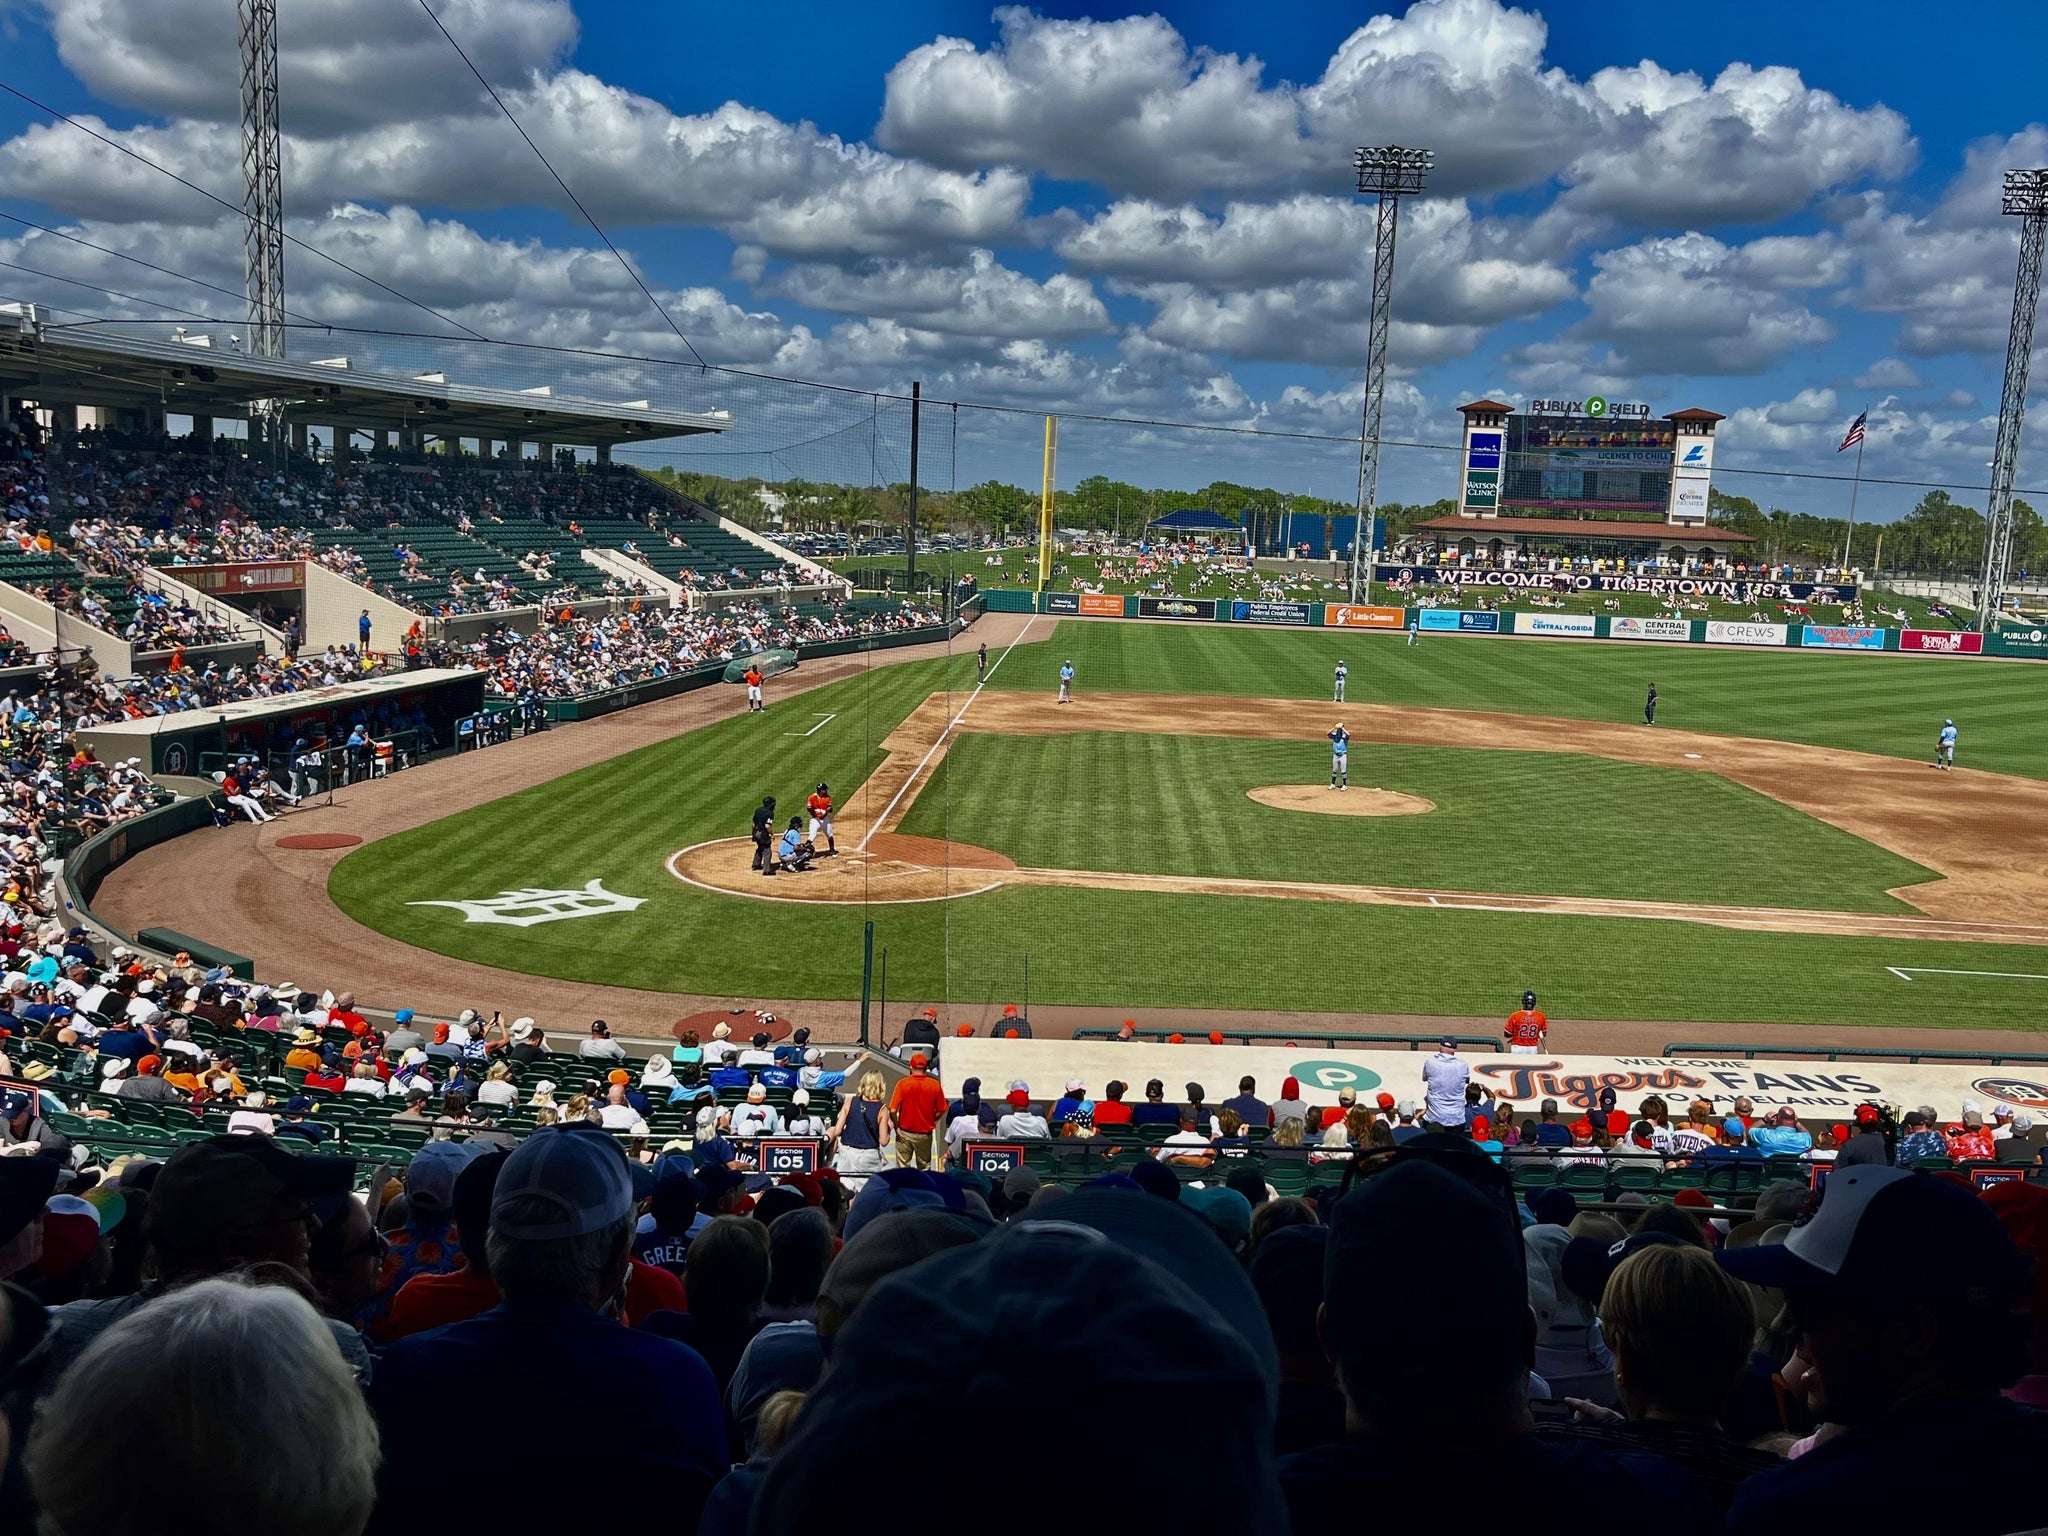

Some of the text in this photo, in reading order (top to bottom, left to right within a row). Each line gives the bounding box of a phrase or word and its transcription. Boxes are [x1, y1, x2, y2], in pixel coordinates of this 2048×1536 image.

[1532, 400, 1583, 413] PUBLIX
[1609, 403, 1650, 415] FIELD
[1598, 452, 1632, 460] LICENSE
[1467, 481, 1499, 490] WATSON
[1435, 570, 1553, 588] WELCOME
[1563, 575, 1592, 589] TO
[1600, 576, 1738, 598] TIGERTOWN
[1746, 583, 1794, 598] USA
[1645, 621, 1687, 629] CENTRAL
[1727, 625, 1775, 638] CREWS
[2002, 632, 2030, 640] PUBLIX
[1519, 1024, 1538, 1038] 28
[1615, 1058, 1751, 1069] WELCOME
[1474, 1061, 1881, 1108] Tigers FANS
[773, 1155, 804, 1169] 105
[980, 1159, 1010, 1172] 104
[643, 1246, 687, 1267] GREE
